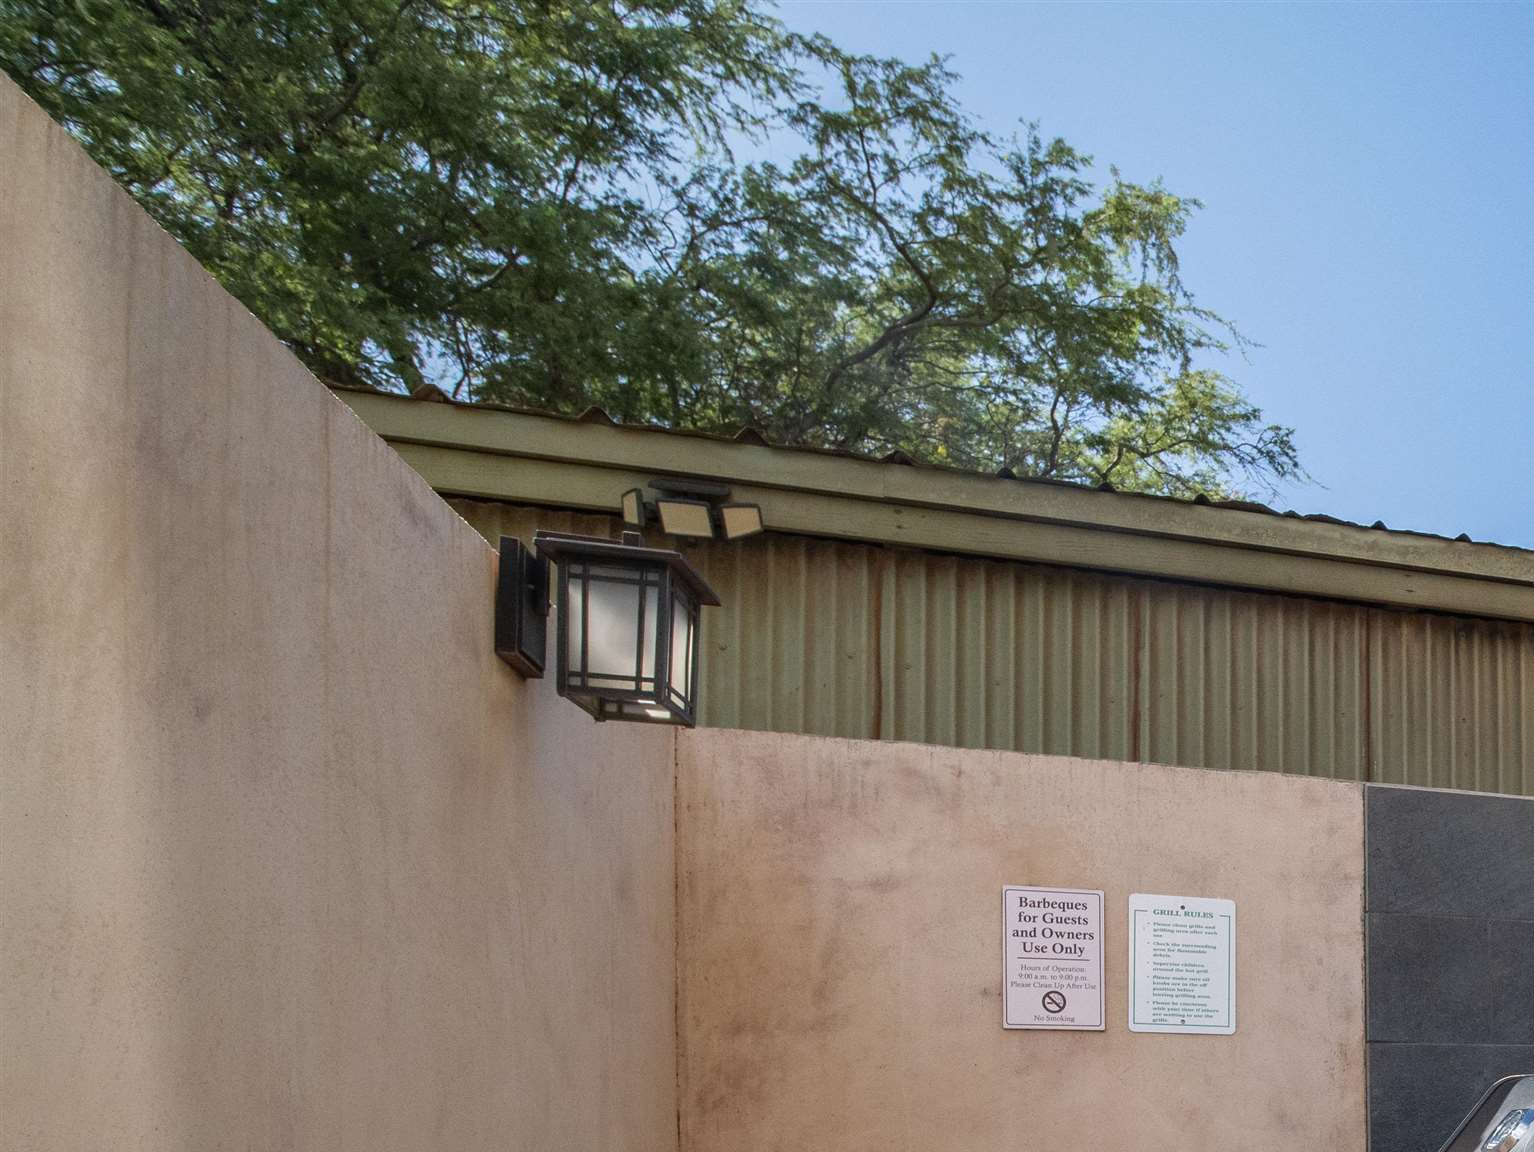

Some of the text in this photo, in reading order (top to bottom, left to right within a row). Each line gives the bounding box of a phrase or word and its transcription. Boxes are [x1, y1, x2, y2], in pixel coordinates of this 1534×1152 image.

[1018, 896, 1088, 912] Barbeques
[1017, 911, 1089, 926] for Guests
[1153, 909, 1181, 917] GRILL
[1012, 927, 1095, 941] and Owners
[1022, 941, 1086, 957] Use Only
[1020, 964, 1041, 972] Hours
[1010, 980, 1031, 988] Please
[1054, 982, 1065, 990] Up
[1046, 1015, 1075, 1023] Smoking
